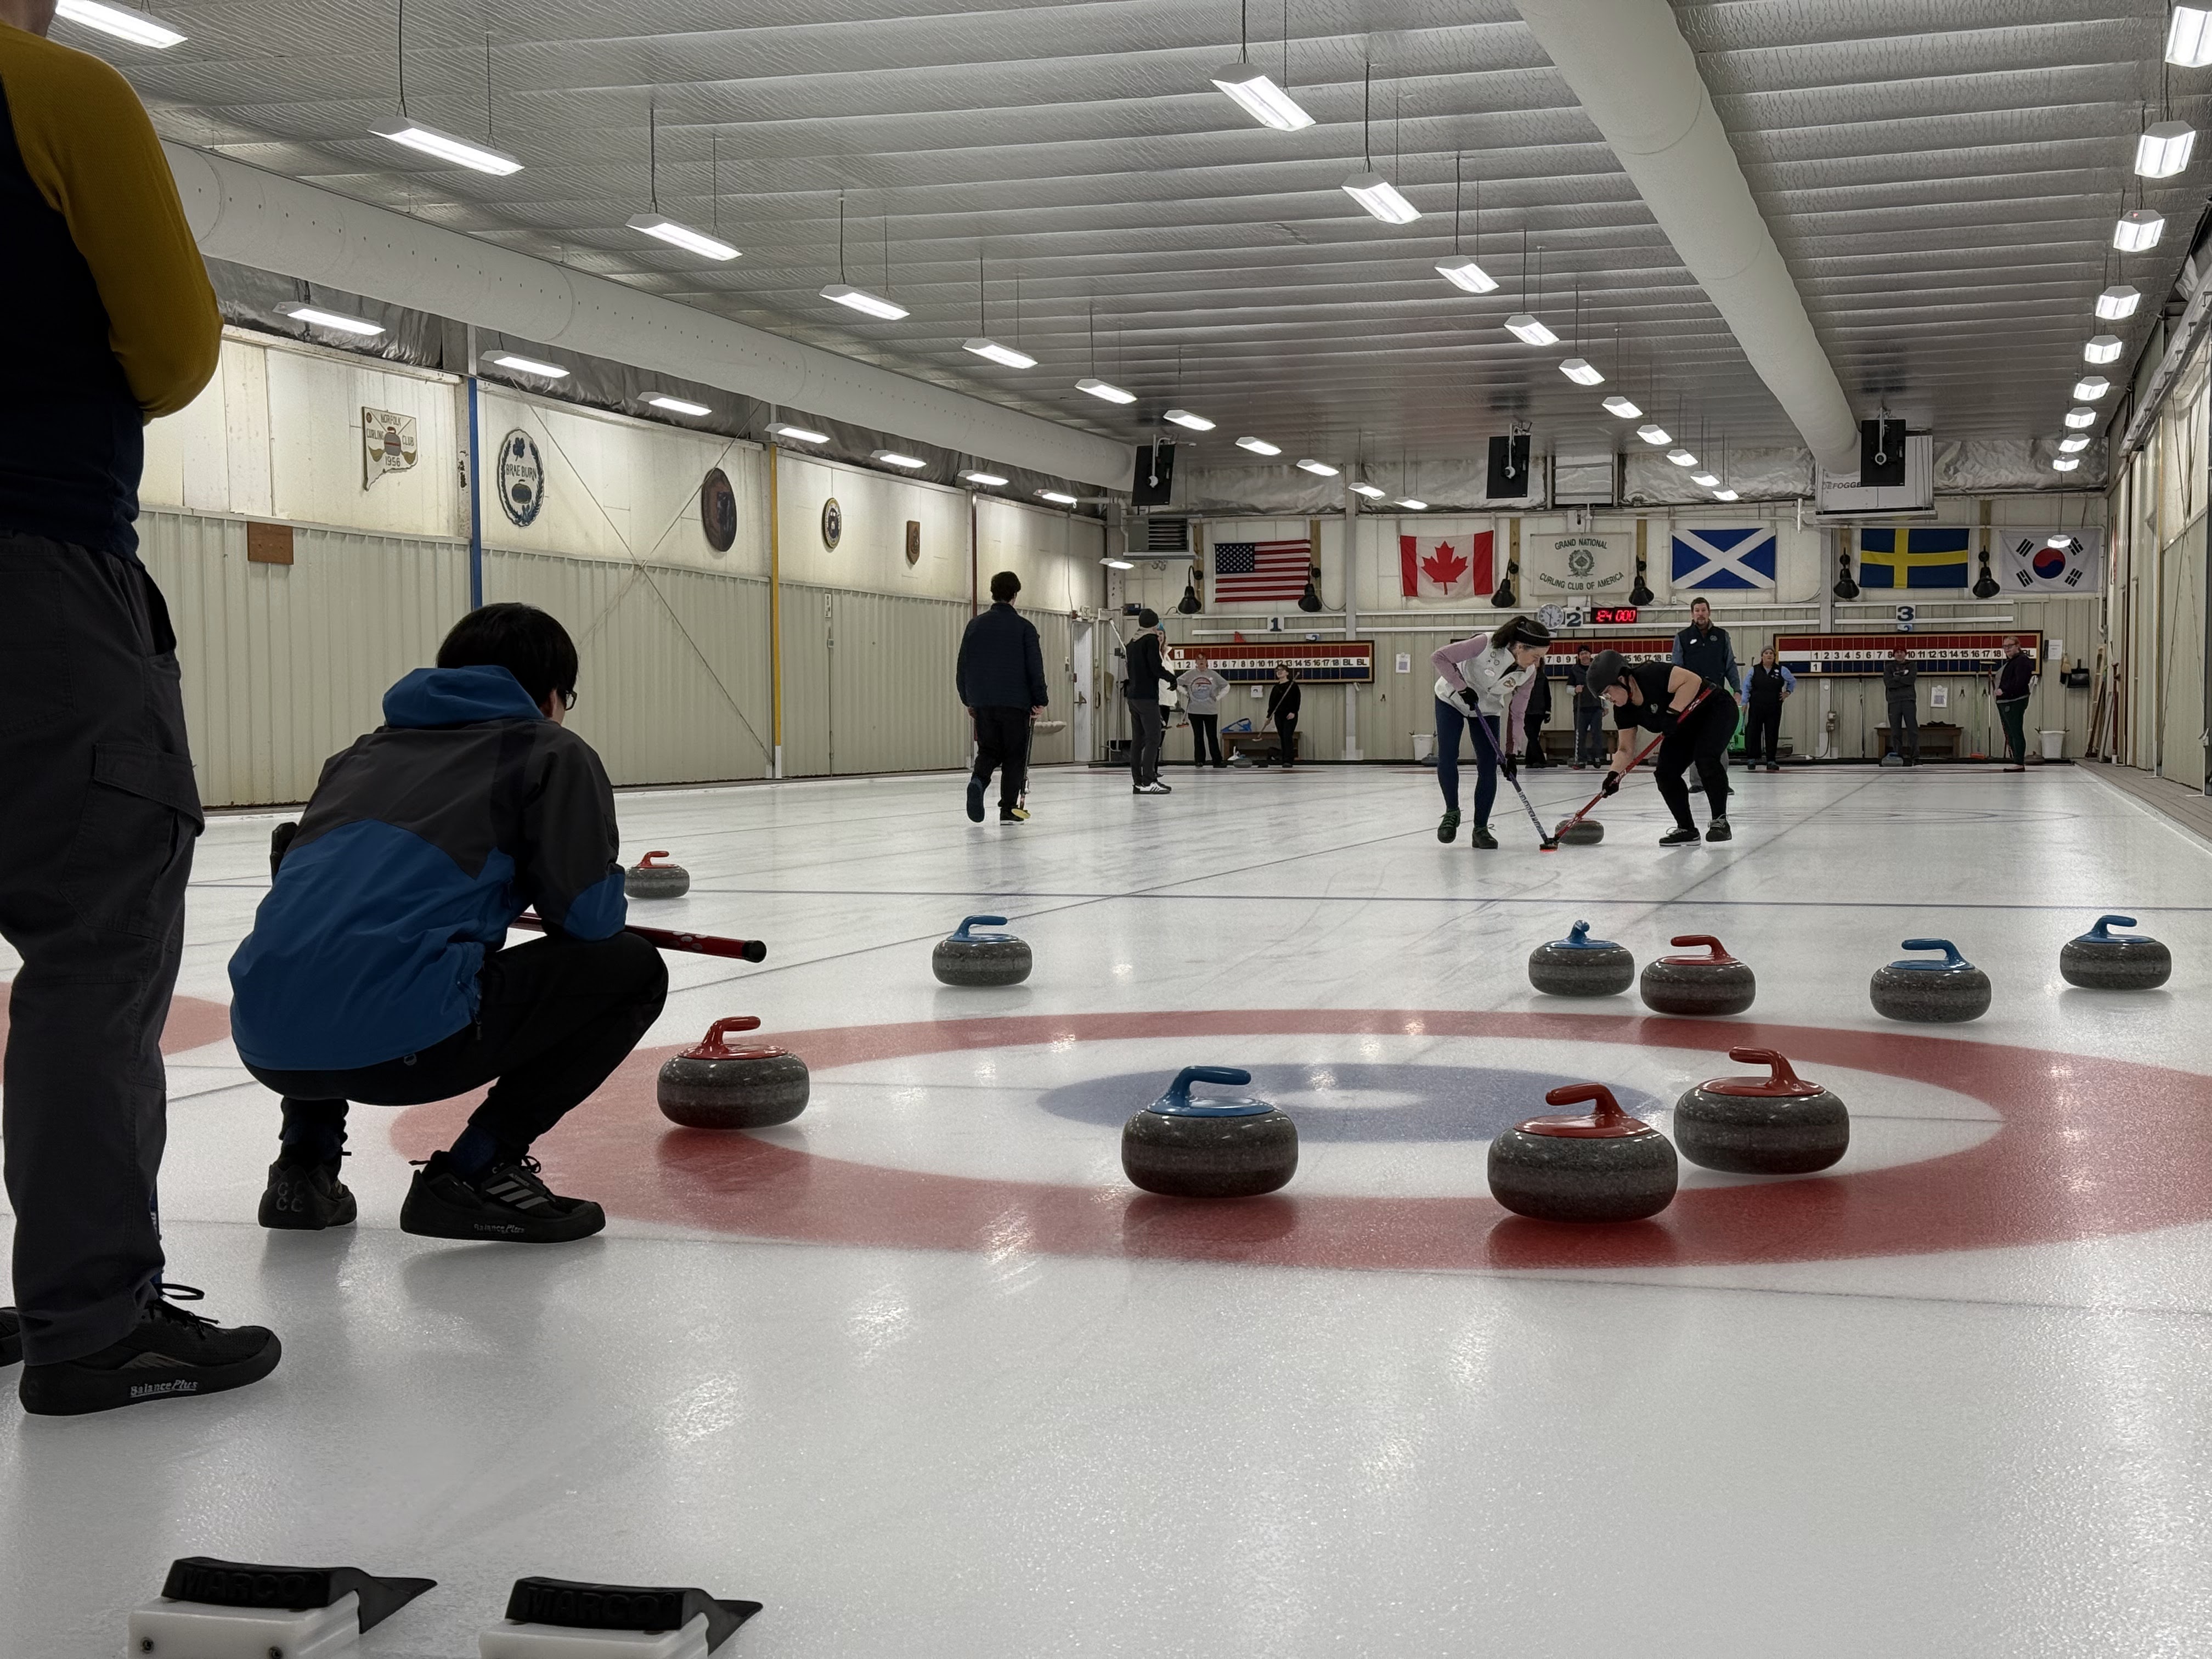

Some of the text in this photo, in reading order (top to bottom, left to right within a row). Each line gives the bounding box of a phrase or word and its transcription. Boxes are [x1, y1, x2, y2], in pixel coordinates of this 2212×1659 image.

[381, 414, 401, 427] NORFOLK
[402, 435, 415, 447] CLUB
[385, 456, 401, 467] 1956
[506, 464, 537, 481] BRAE BURN
[1555, 538, 1607, 550] GRAND NATIONAL
[1539, 572, 1624, 590] CURLING CLUB OF AMERICA
[1566, 612, 1581, 627] 2
[1897, 606, 1914, 622] 3
[1269, 617, 1282, 631] 1
